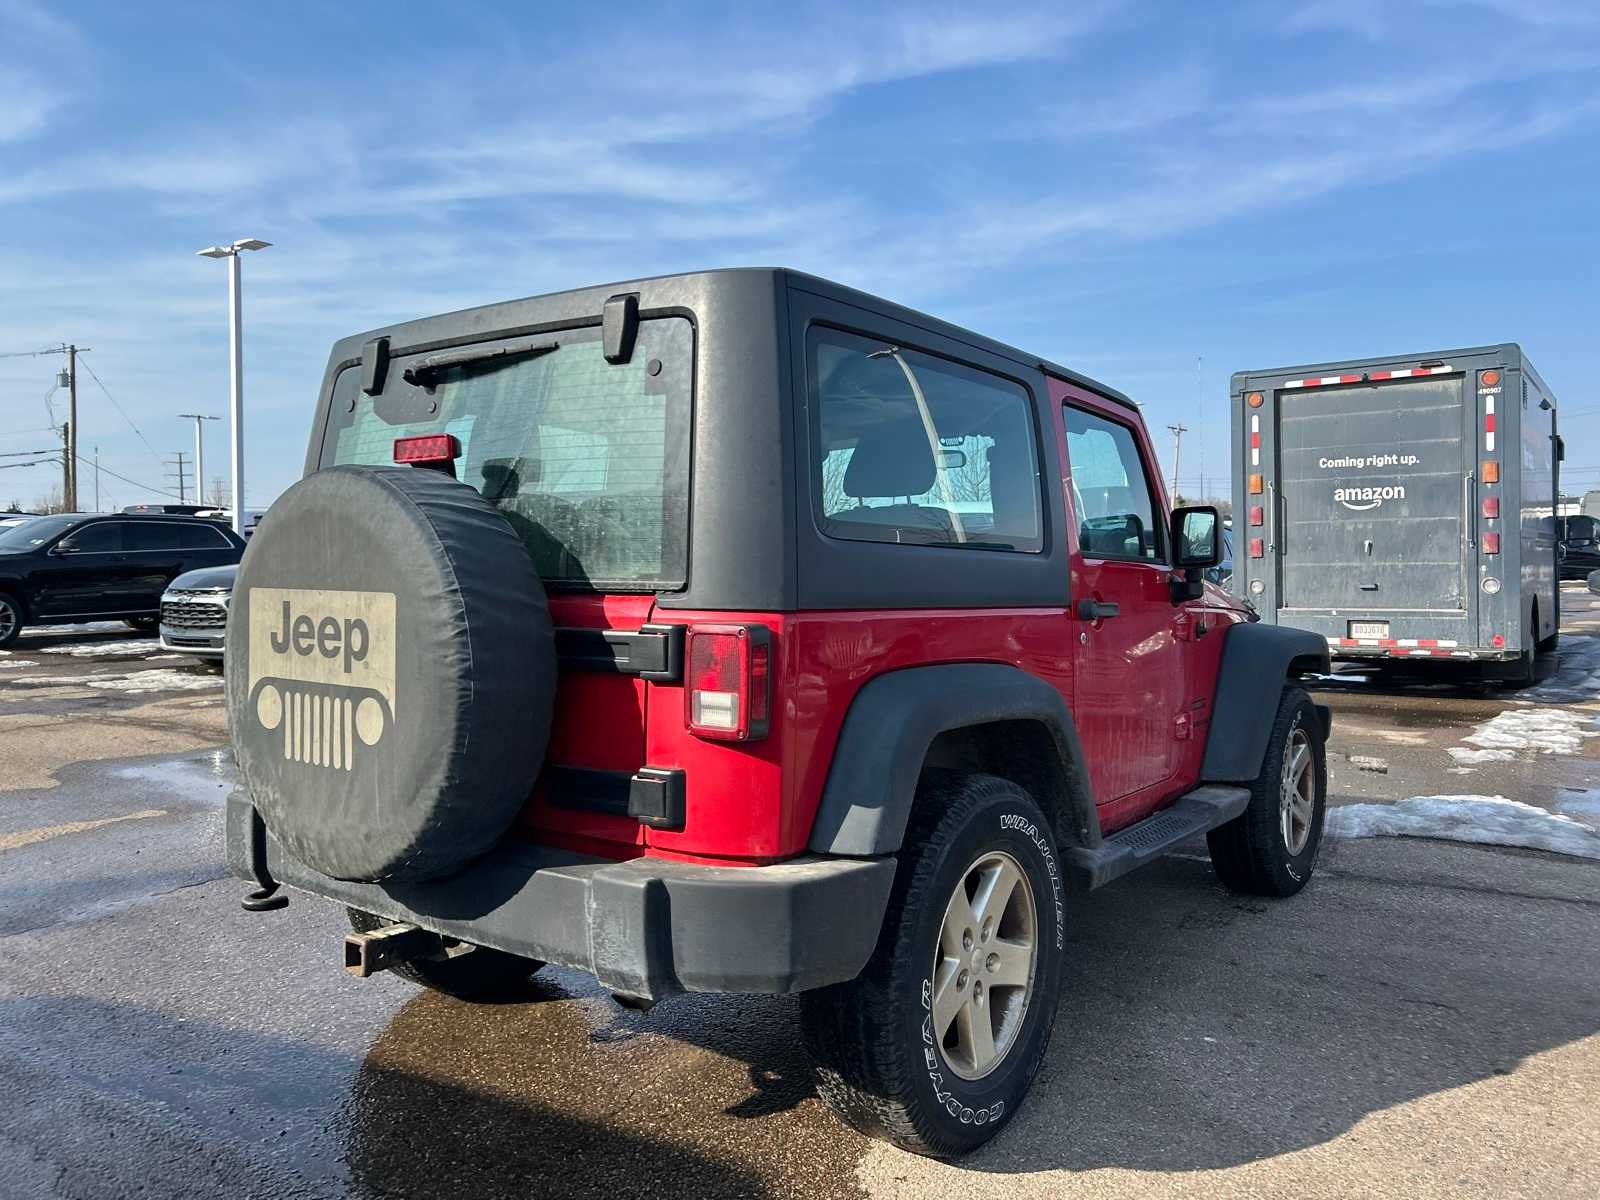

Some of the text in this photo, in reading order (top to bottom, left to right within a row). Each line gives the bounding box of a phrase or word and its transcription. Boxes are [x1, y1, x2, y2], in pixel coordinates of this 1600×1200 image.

[1319, 454, 1420, 469] Coming right up.
[1334, 486, 1405, 502] amazon
[270, 600, 370, 674] Jeep
[1000, 814, 1066, 950] WRANGLER
[921, 978, 1005, 1126] GOODYEAR
